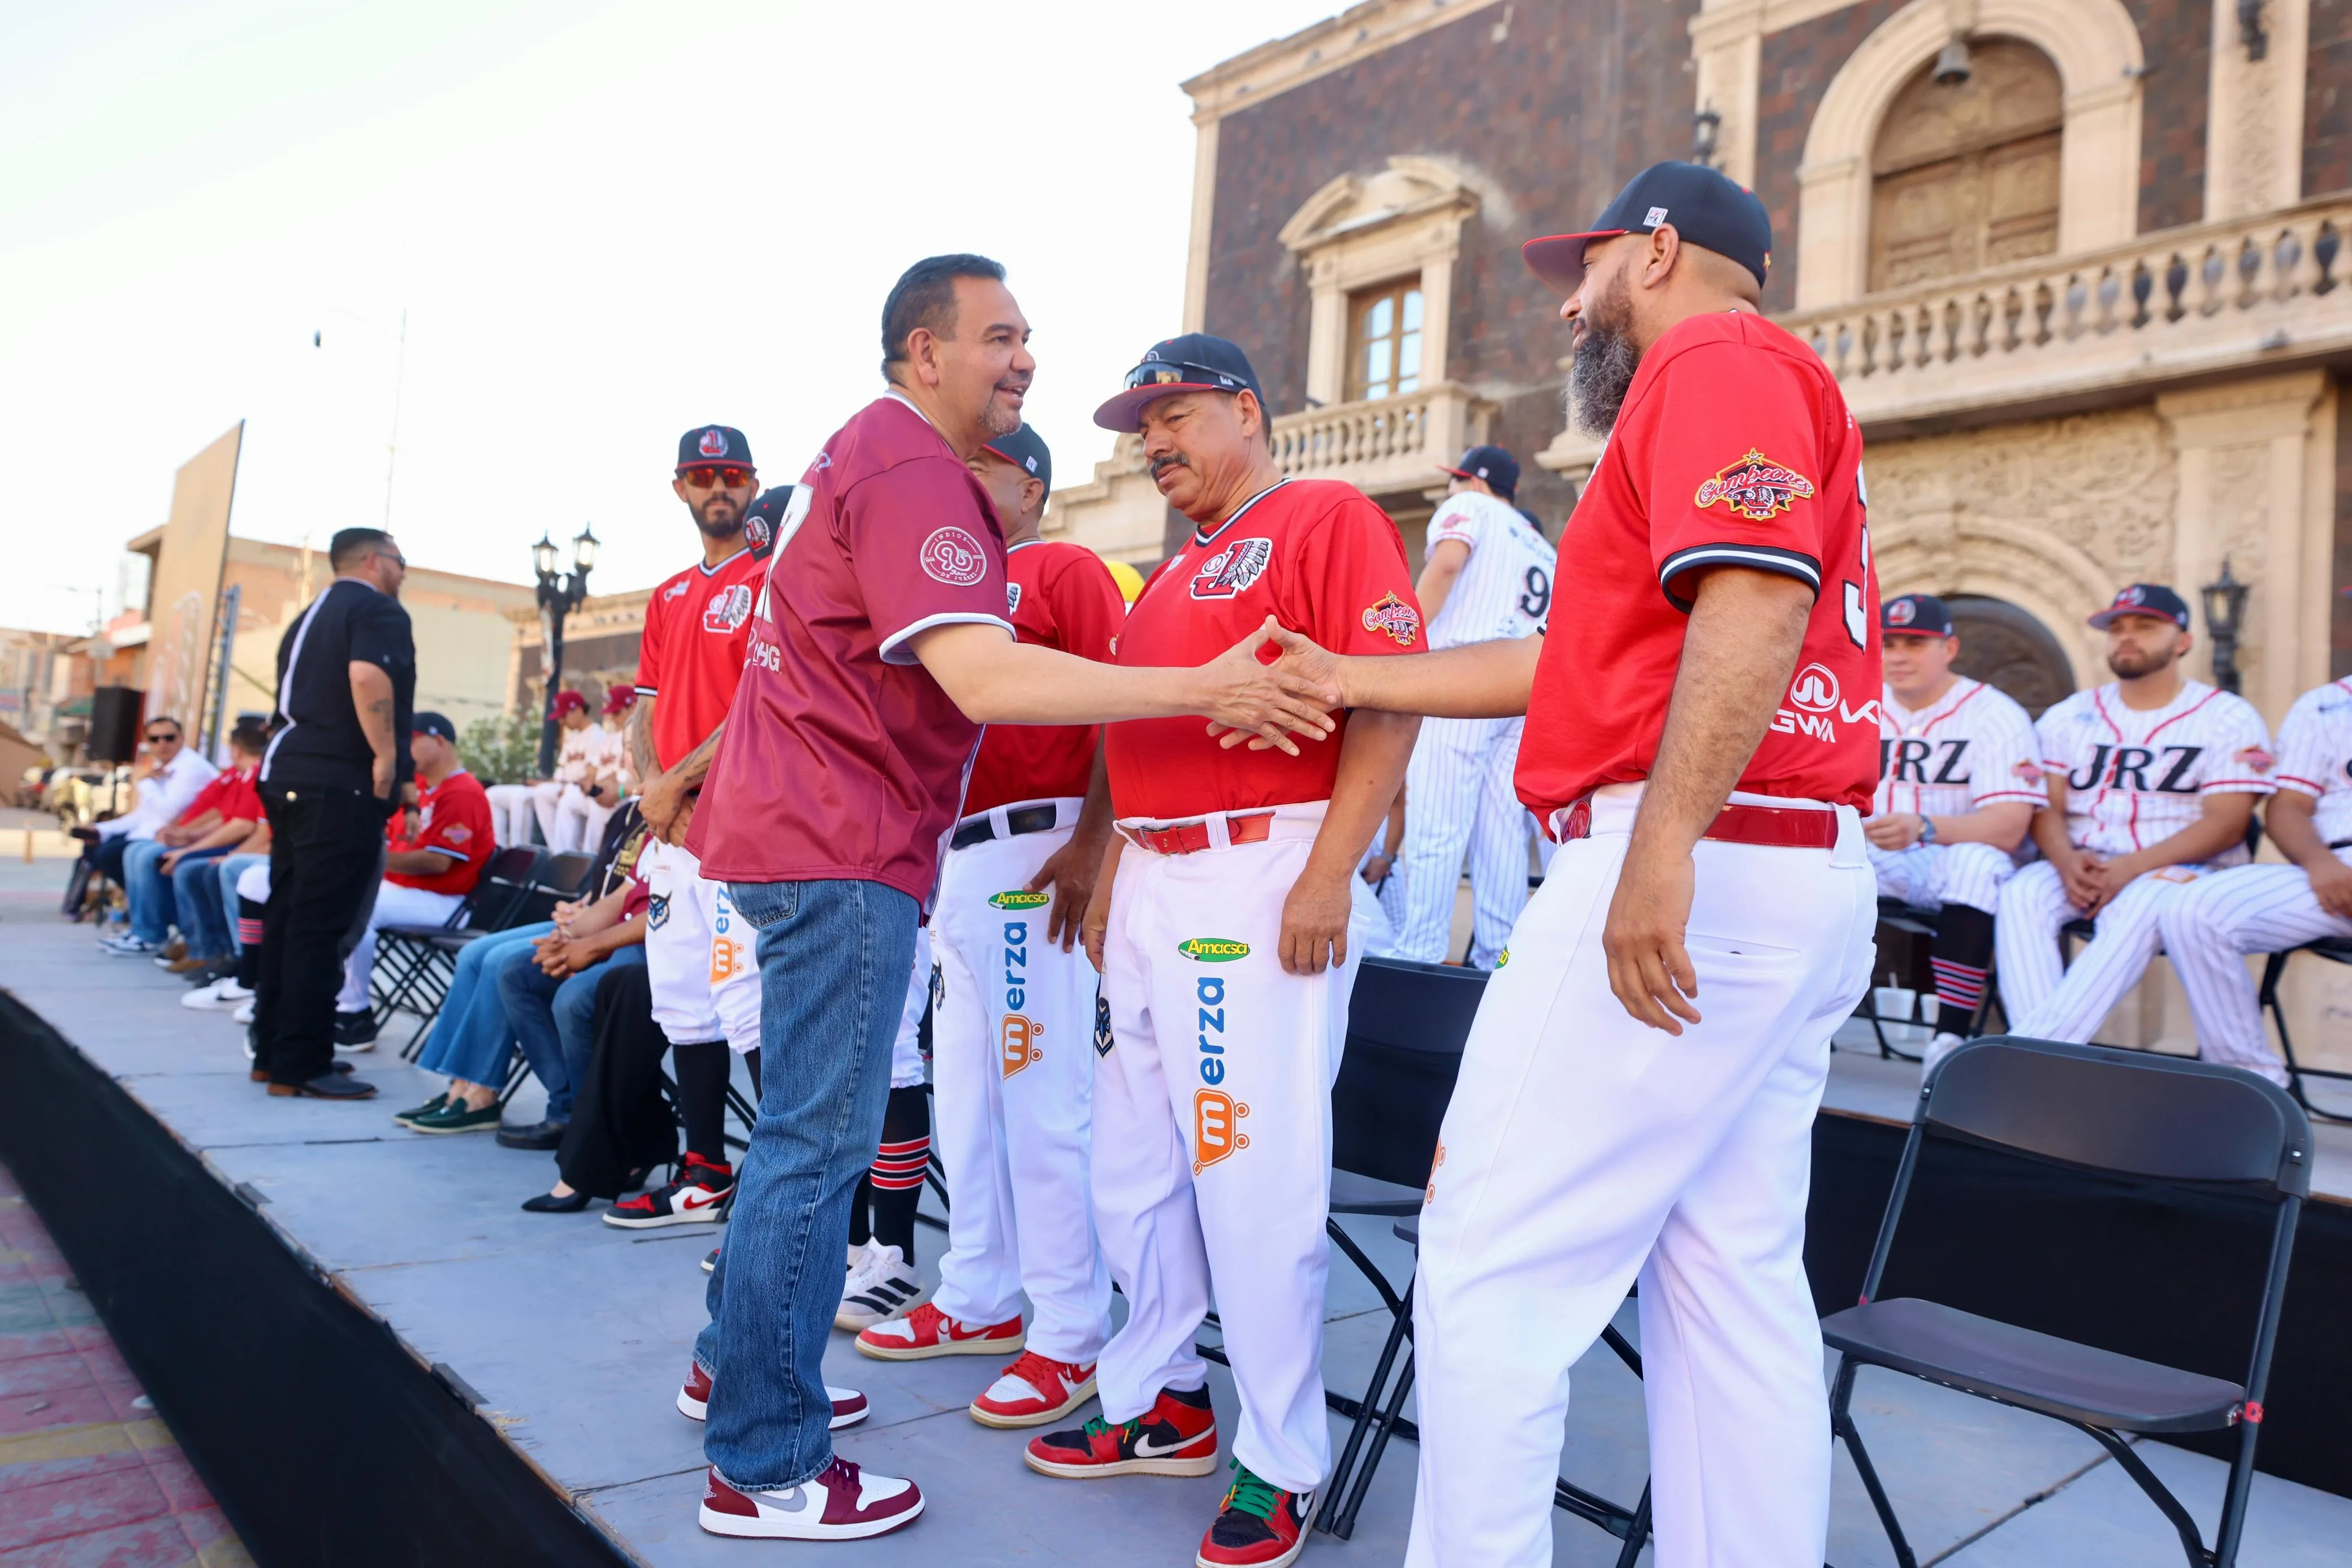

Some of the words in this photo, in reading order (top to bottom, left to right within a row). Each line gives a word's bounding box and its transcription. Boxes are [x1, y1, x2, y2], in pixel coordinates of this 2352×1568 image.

[1698, 465, 1813, 505] Campeones
[934, 532, 968, 543] INDIOS
[1520, 566, 1550, 618] 9
[2068, 743, 2206, 794] JRZ
[996, 891, 1048, 904] Amacsa
[715, 885, 732, 973] merz
[1187, 938, 1248, 955] Amacsa
[1004, 922, 1027, 1060] merza
[1197, 977, 1226, 1146] merza
